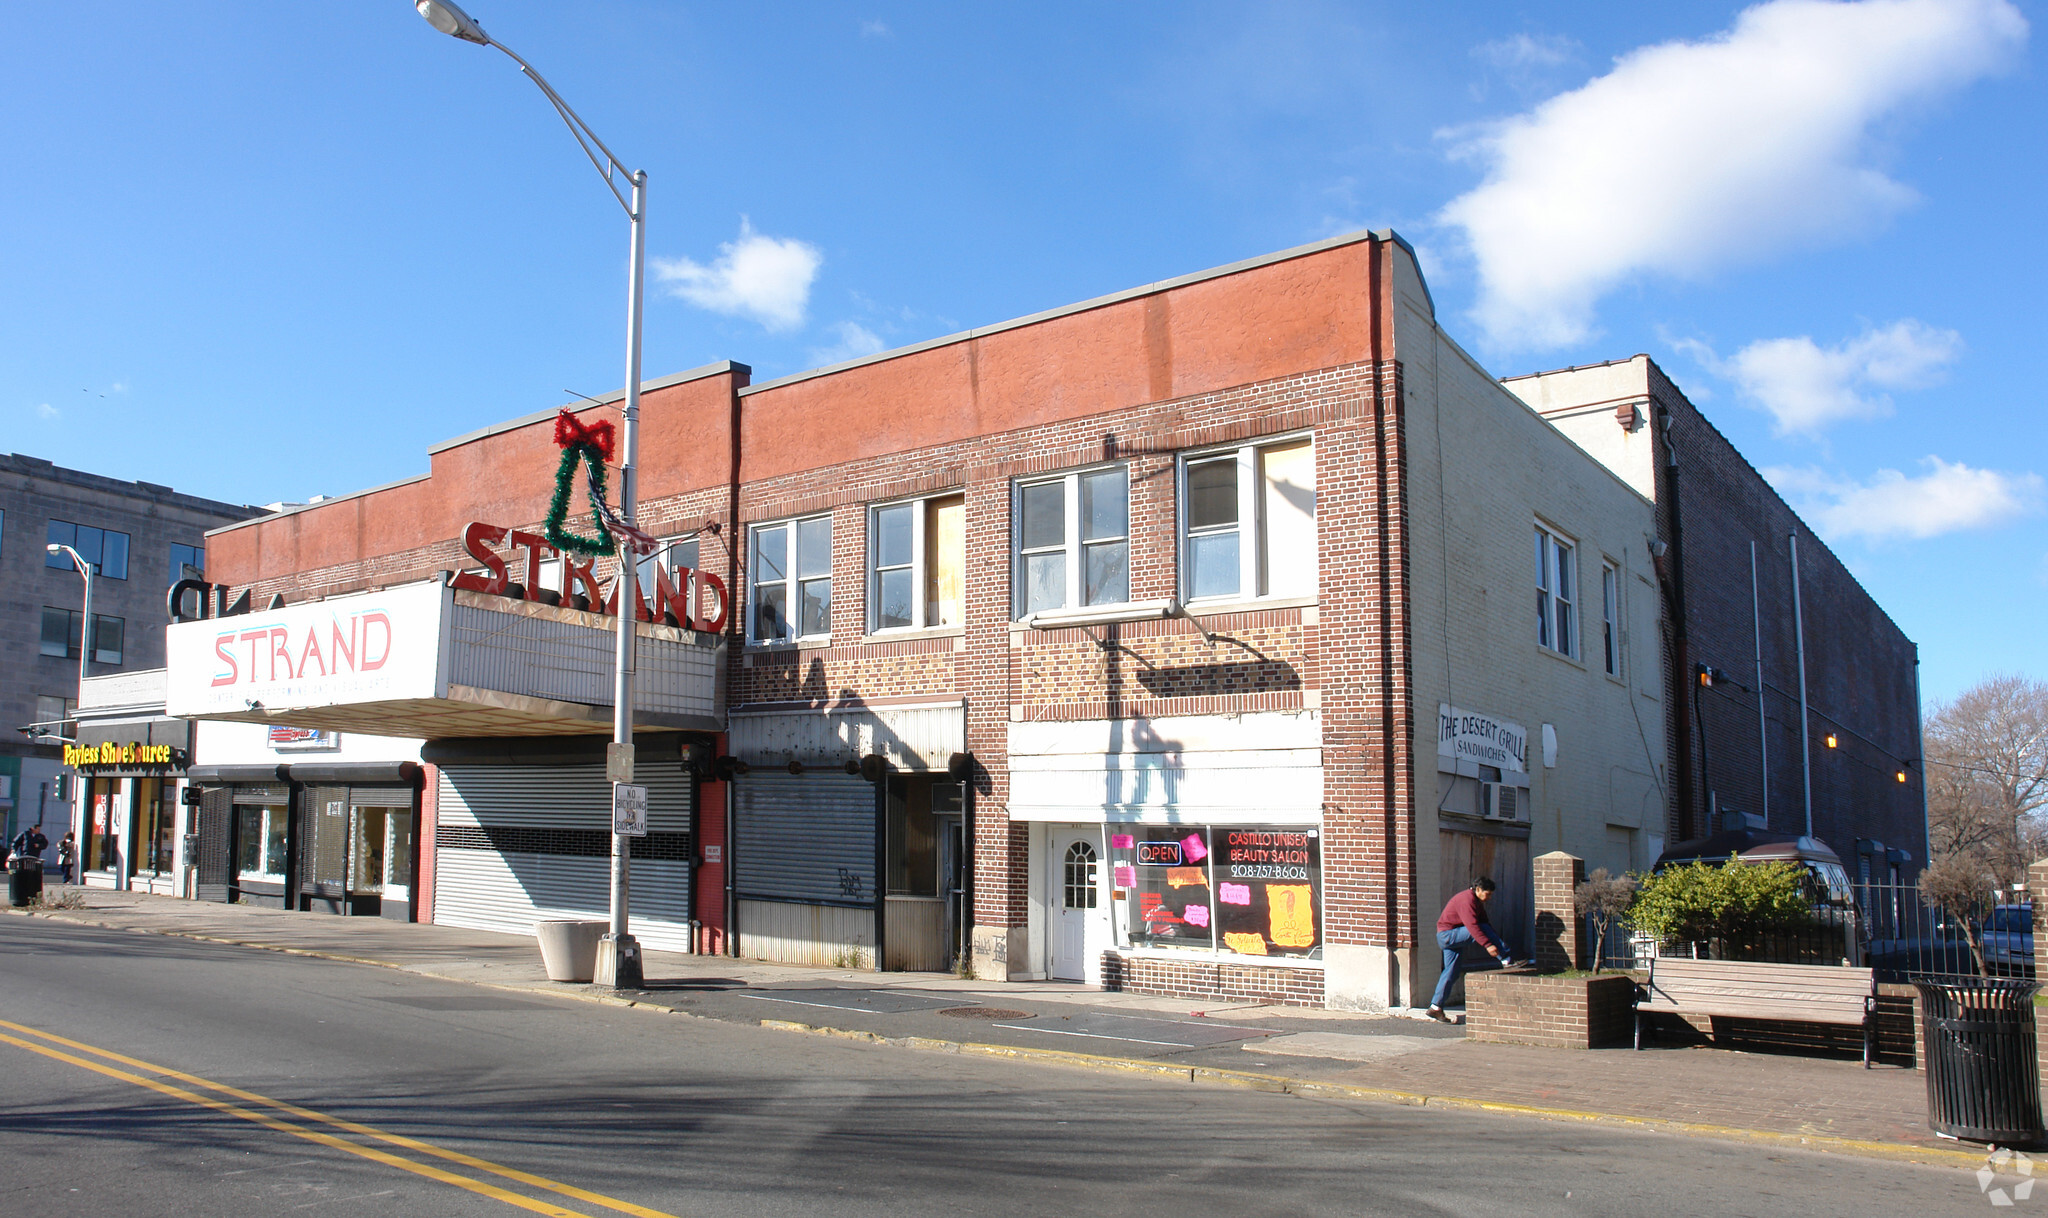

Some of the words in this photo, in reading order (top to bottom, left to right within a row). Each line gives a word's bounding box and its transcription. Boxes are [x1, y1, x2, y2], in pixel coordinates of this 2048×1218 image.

[210, 613, 392, 687] STRAND
[1441, 714, 1458, 742] THE
[1462, 716, 1498, 740] DESERT
[1498, 729, 1523, 762] GRILL
[63, 743, 99, 769] Payless
[1457, 739, 1507, 762] SANDWICHES
[626, 789, 636, 799] NO
[616, 820, 645, 832] SIDEWALK
[1228, 832, 1271, 846] CASTILLO
[1273, 833, 1308, 847] UNISEX
[1140, 846, 1178, 861] OPEN
[1230, 849, 1269, 862] BEAUTY
[1271, 850, 1309, 864] SALON
[1230, 864, 1307, 879] 908-757-8606
